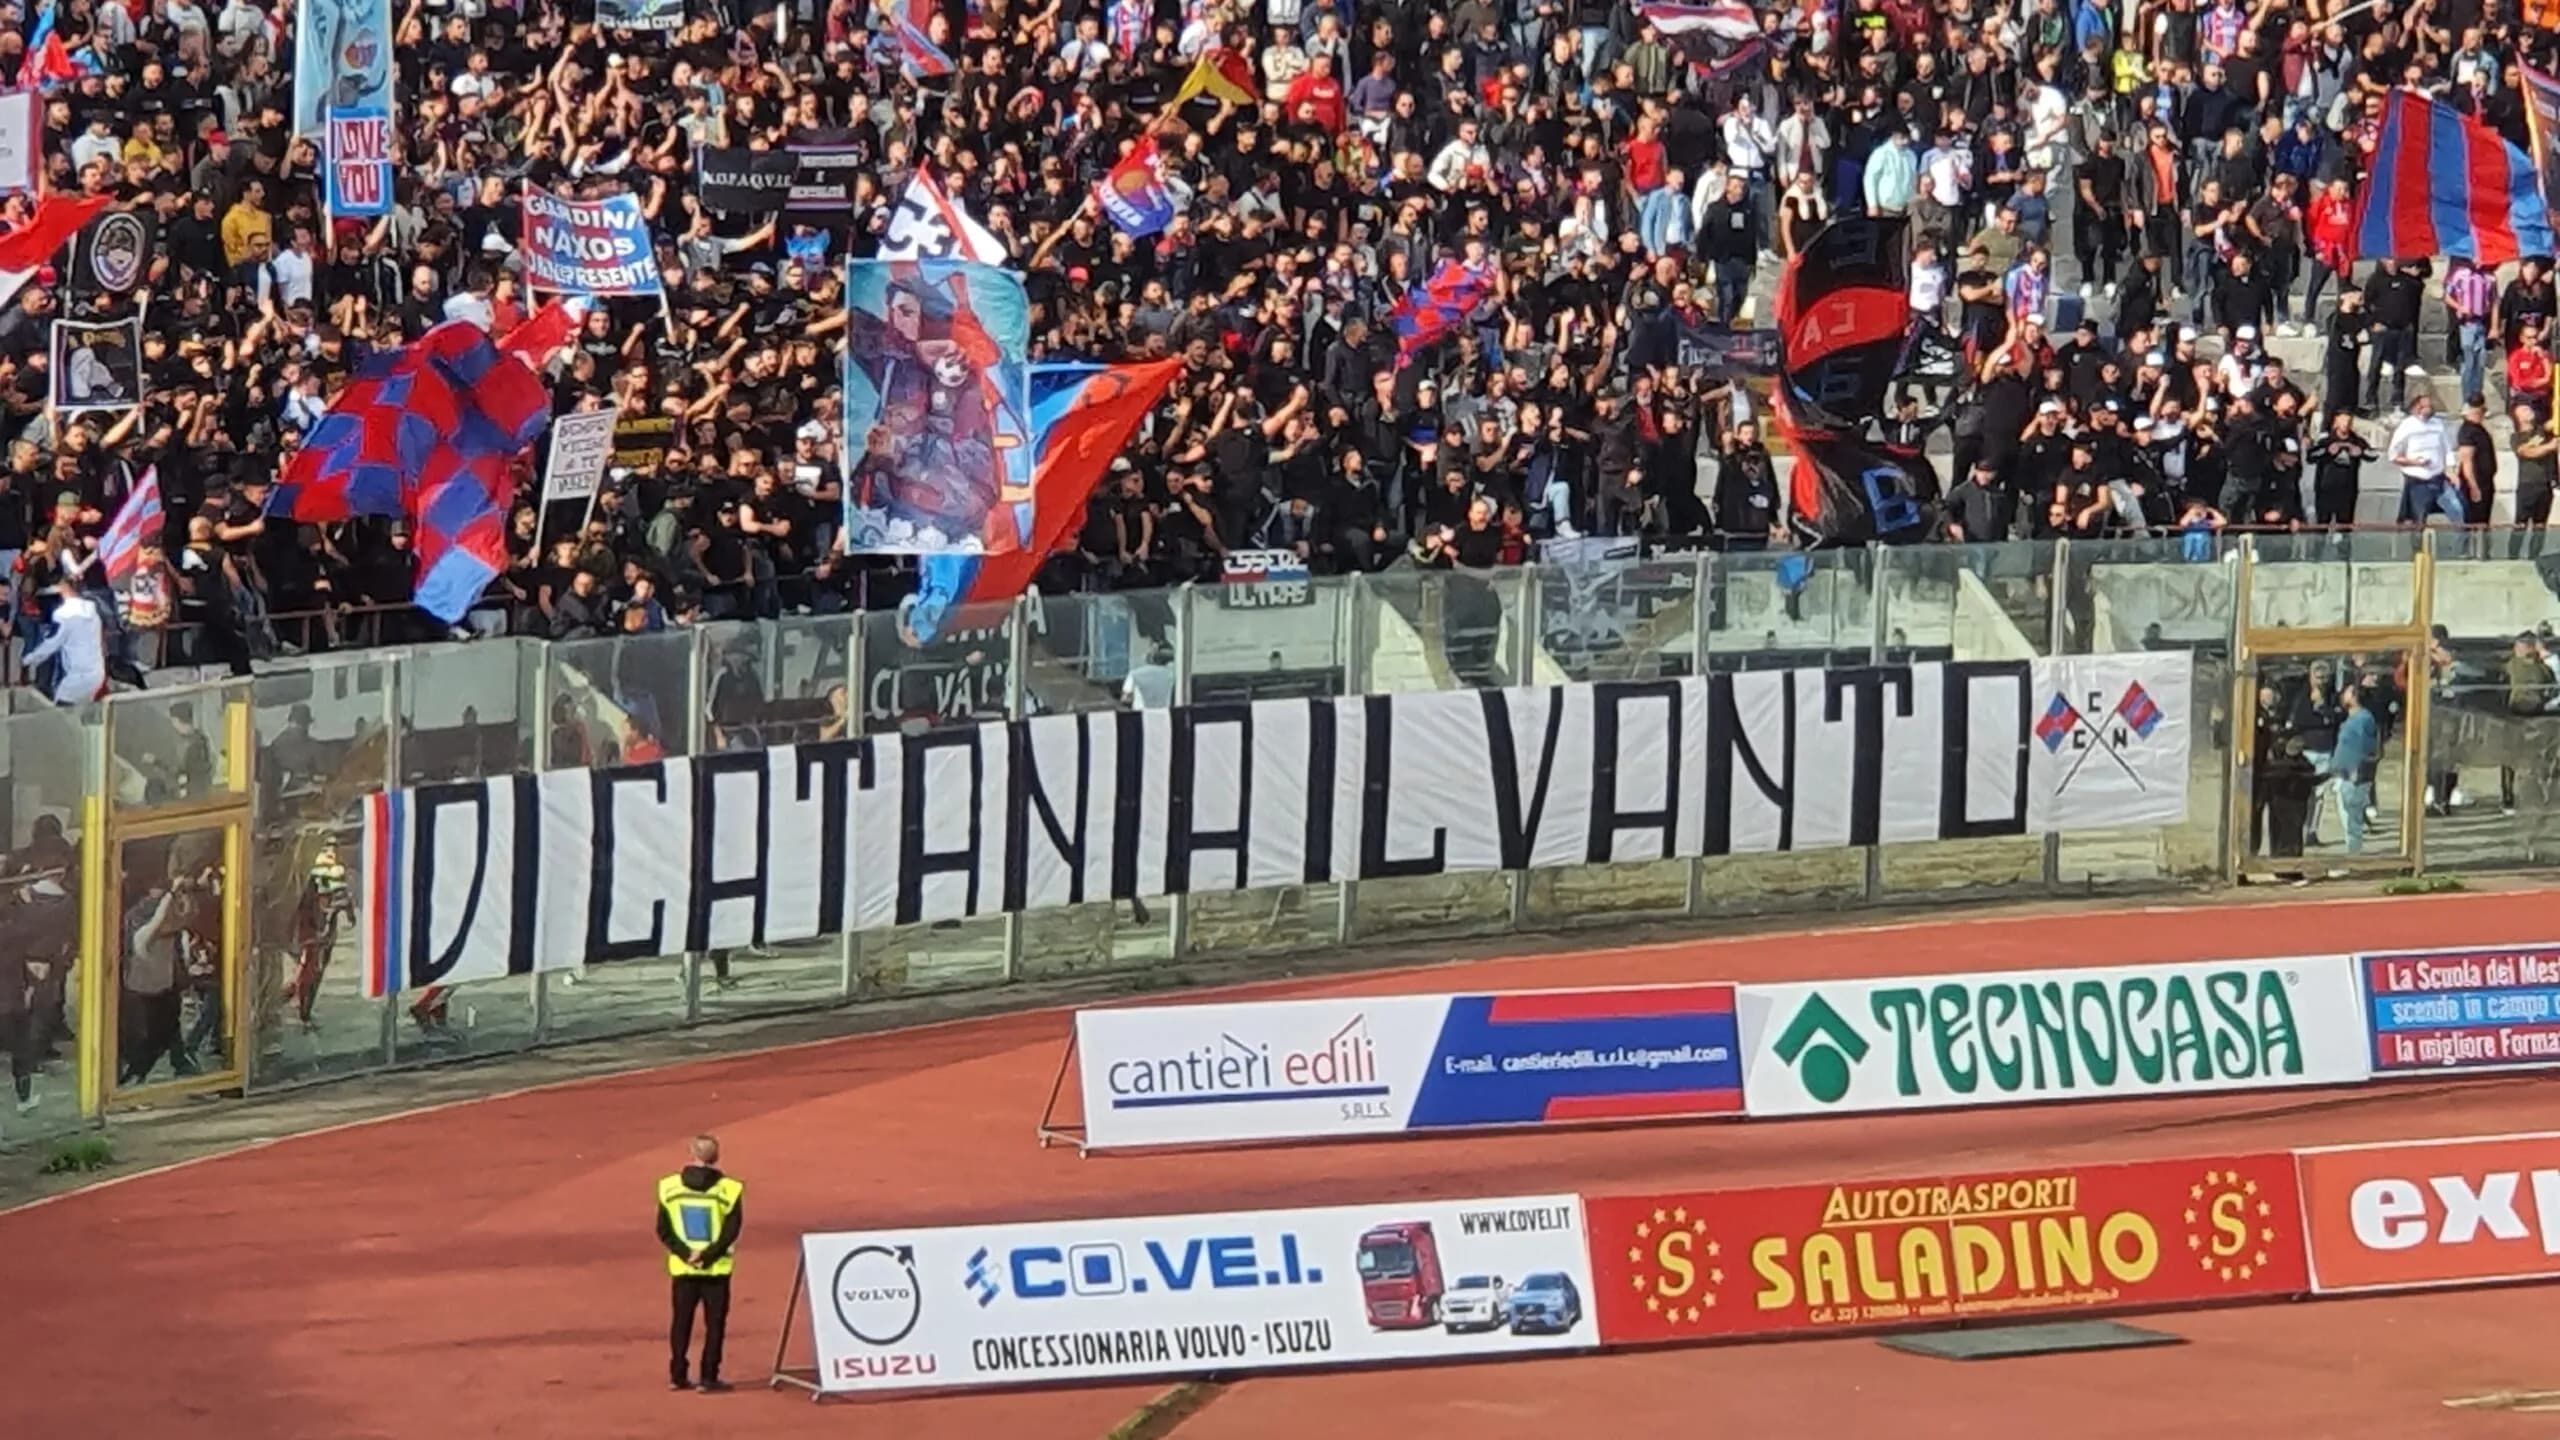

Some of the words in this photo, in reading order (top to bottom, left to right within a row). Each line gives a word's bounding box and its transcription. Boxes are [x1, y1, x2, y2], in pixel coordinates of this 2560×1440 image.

[339, 120, 387, 159] LOVE
[338, 163, 381, 204] YOU
[534, 226, 637, 262] NAXOS
[1224, 548, 1309, 574] ESSERE
[1229, 581, 1309, 607] ULTRAS
[2112, 727, 2127, 749] N
[410, 774, 540, 988] DI
[585, 693, 1253, 964] CATANIA
[1304, 692, 1447, 884] IL
[1478, 659, 2033, 871] VANTO
[2388, 962, 2414, 991] La
[2416, 958, 2483, 990] Scuola
[2486, 956, 2516, 987] dei
[2487, 994, 2550, 1024] campo
[1870, 970, 2304, 1097] TECNOCASA
[2394, 1034, 2416, 1063] la
[2418, 1030, 2496, 1066] migliore
[1108, 1040, 1271, 1095] cantieri
[1285, 1032, 1376, 1086] edili
[1822, 1176, 2078, 1222] AUTOTRASPORTI
[2210, 1192, 2248, 1256] S
[1658, 1230, 1696, 1297] S
[1752, 1211, 2160, 1310] SALADINO
[843, 1287, 910, 1303] VOLVO
[972, 1327, 1172, 1372] CONCESSIONARIA
[1174, 1323, 1247, 1360] VOLVO
[1264, 1318, 1333, 1355] ISUZU
[832, 1352, 938, 1380] ISUZU
